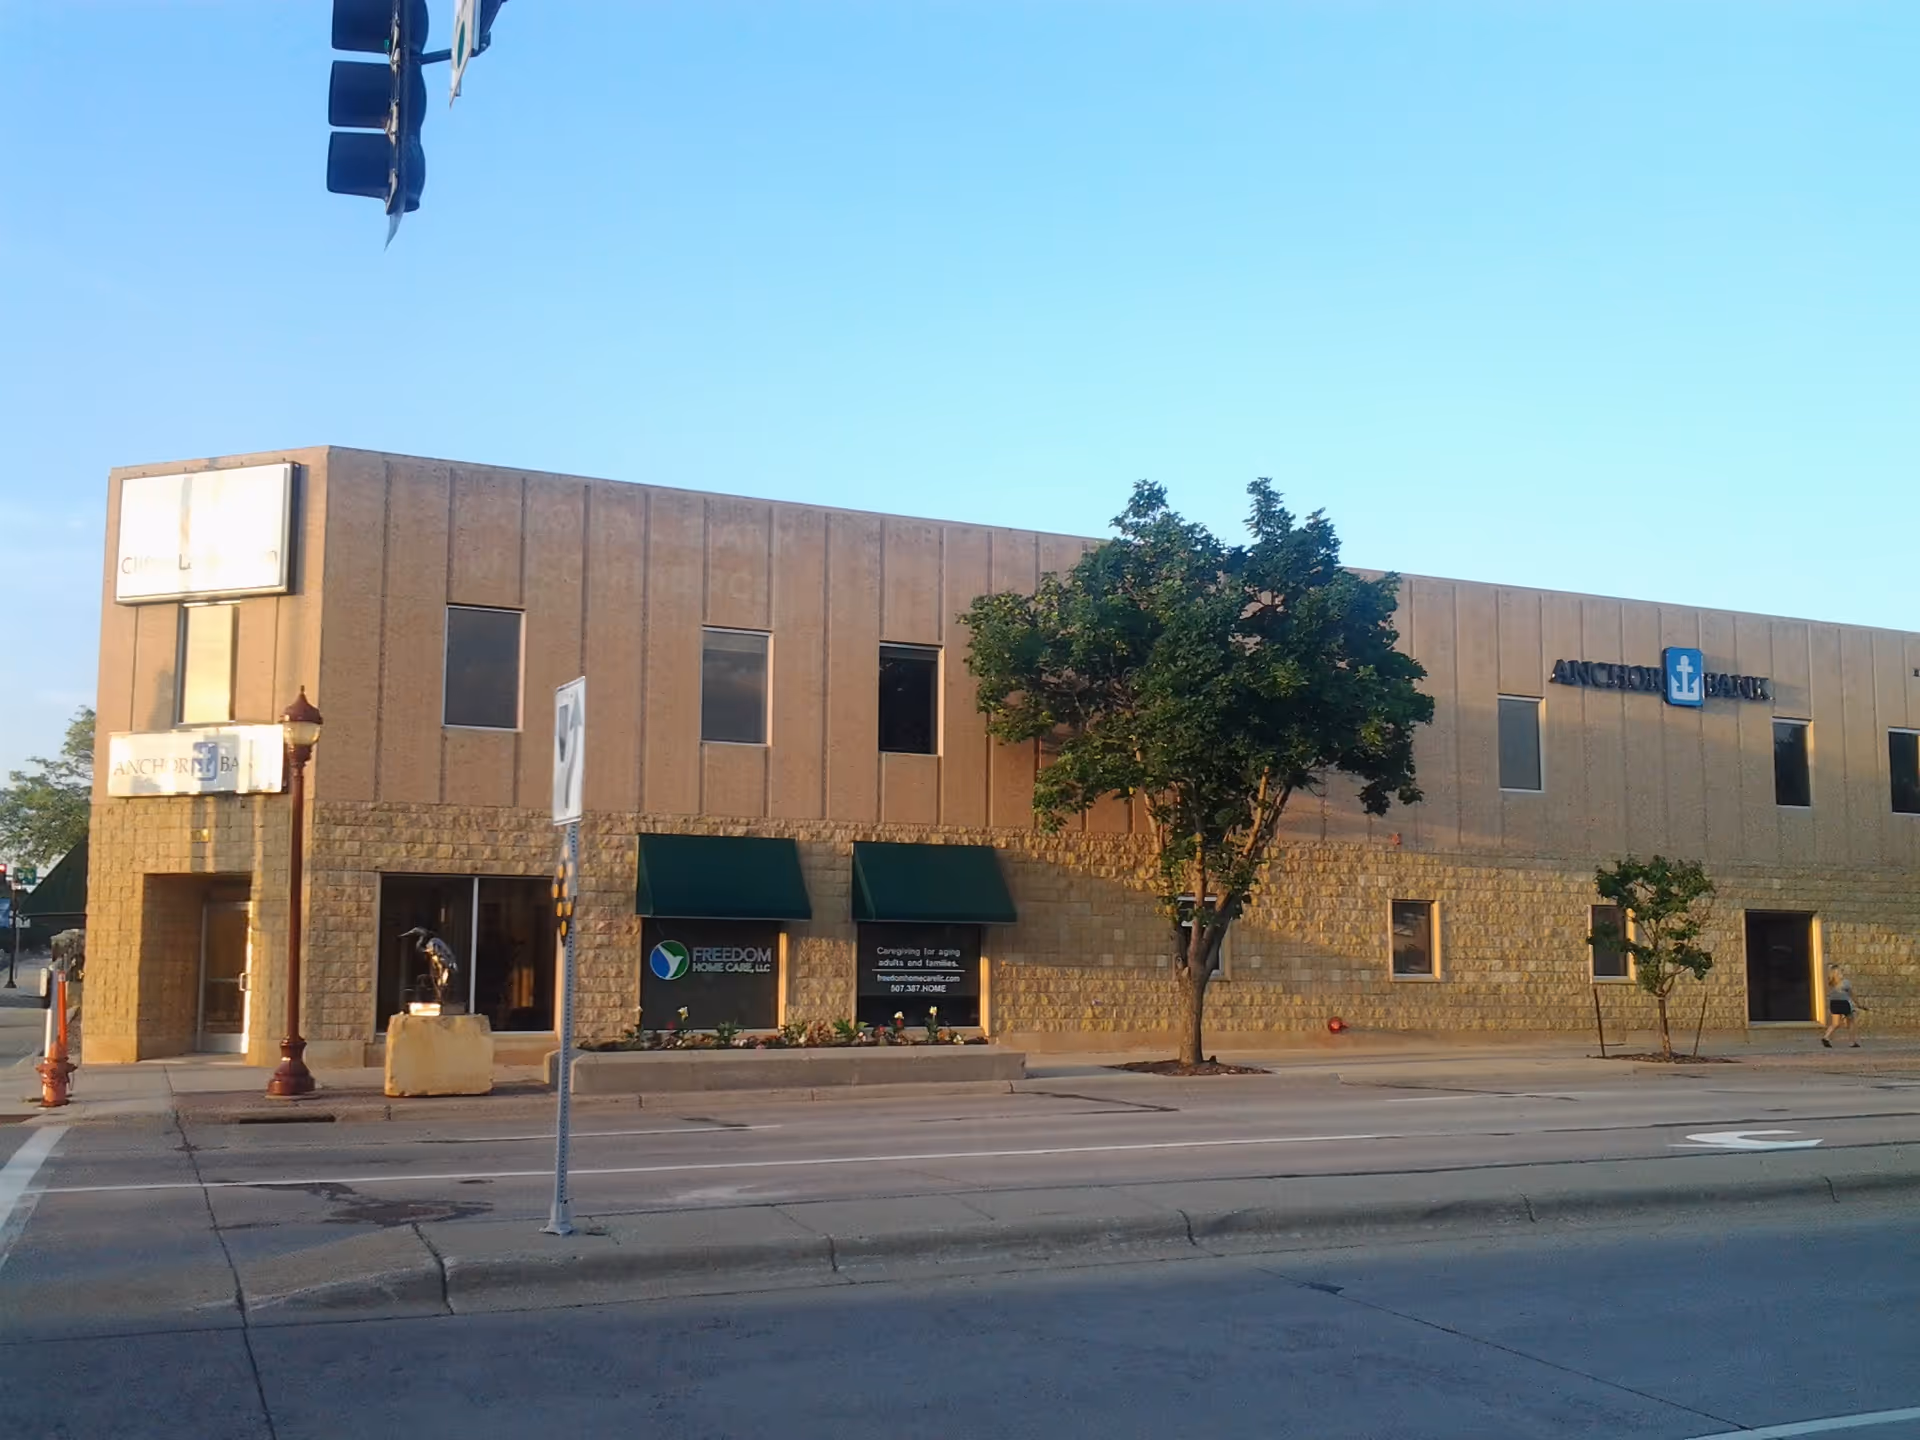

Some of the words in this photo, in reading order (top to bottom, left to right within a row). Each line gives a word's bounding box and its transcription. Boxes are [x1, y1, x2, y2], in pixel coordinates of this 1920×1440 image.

[1703, 672, 1775, 700] BANK
[692, 947, 772, 962] FREEDOM
[876, 946, 921, 956] Caregiving
[924, 947, 936, 955] for
[938, 948, 961, 957] aging
[692, 962, 724, 972] HOME
[725, 962, 754, 973] CARE,
[755, 963, 771, 972] LLC
[907, 959, 922, 967] and
[925, 959, 959, 967] families.
[890, 984, 947, 992] 507.387.HOME
